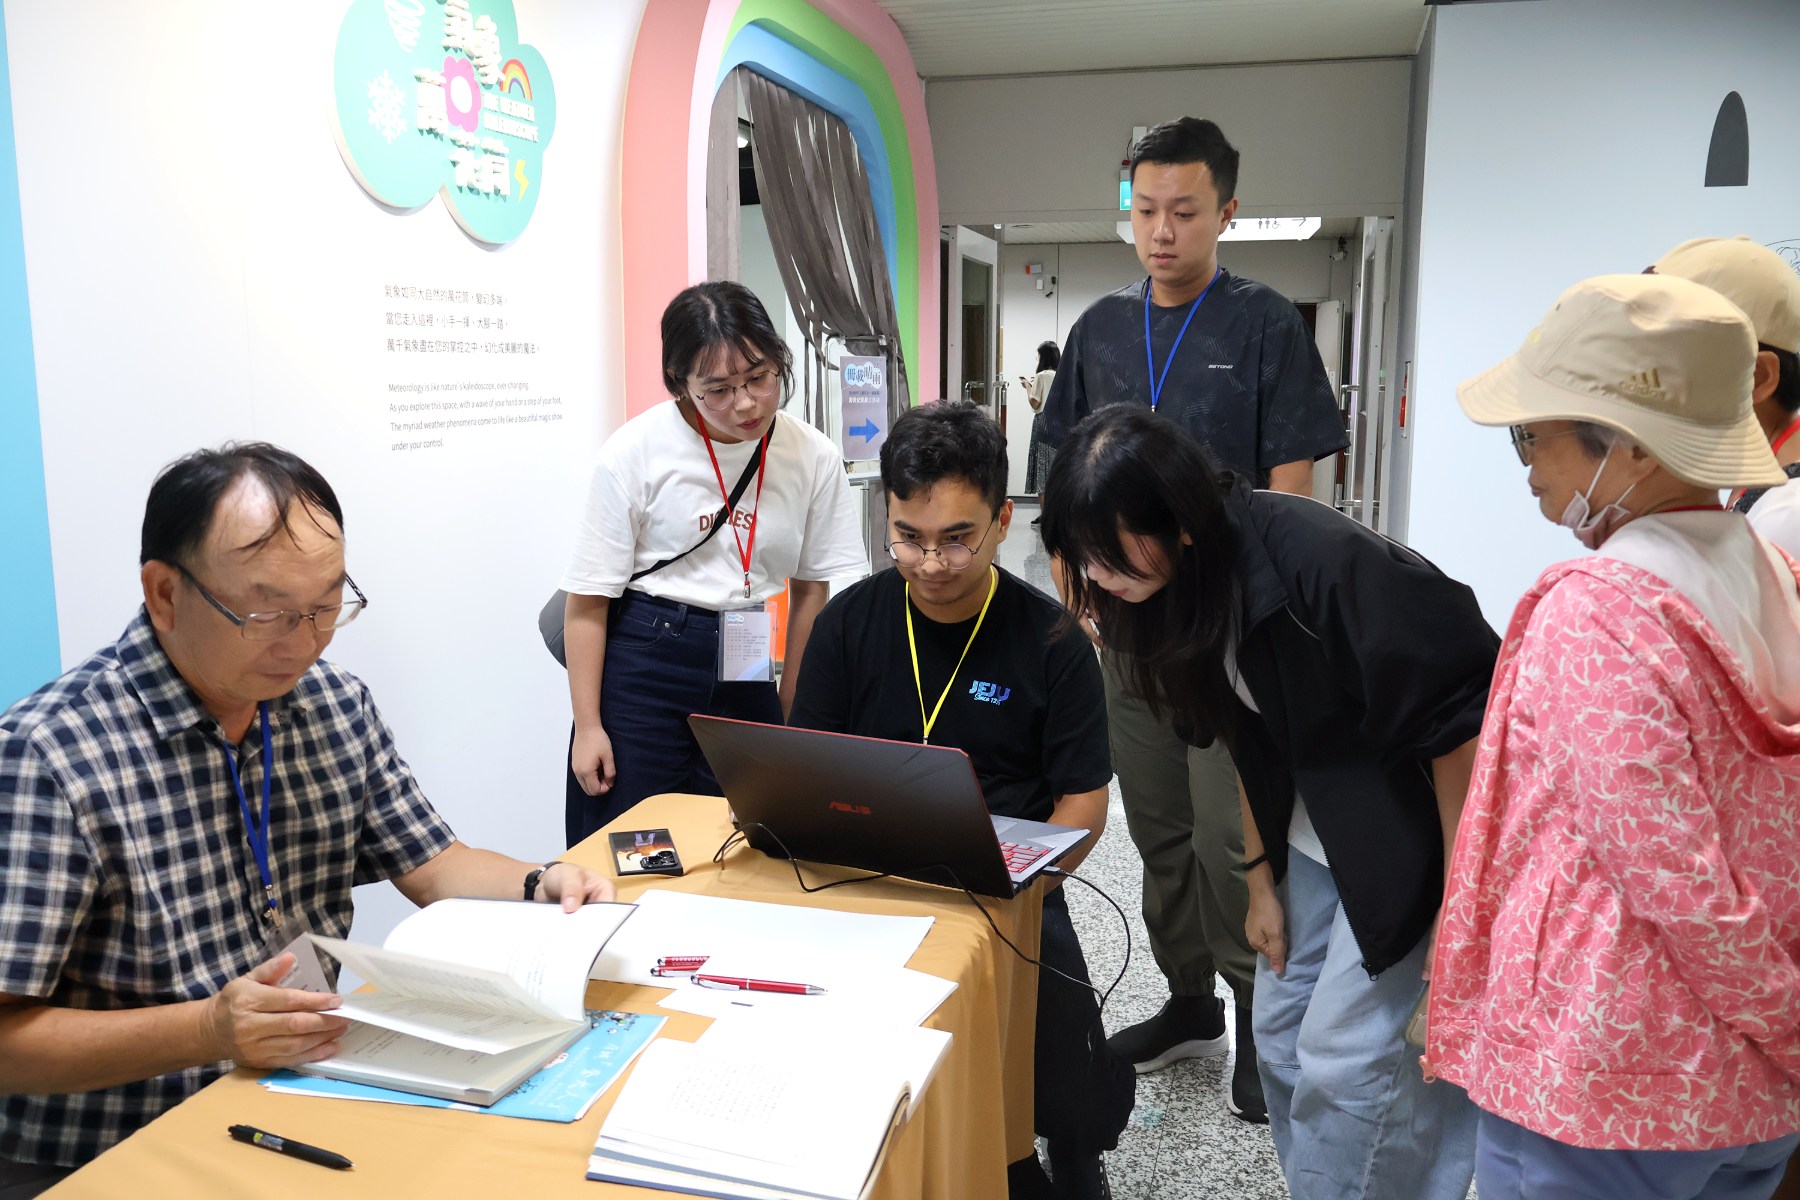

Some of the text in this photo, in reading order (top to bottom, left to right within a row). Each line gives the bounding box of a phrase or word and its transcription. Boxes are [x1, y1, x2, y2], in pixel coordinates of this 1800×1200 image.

[388, 382, 424, 395] Meteorology
[425, 384, 430, 392] is
[430, 383, 440, 392] like
[389, 403, 397, 412] As
[398, 404, 409, 414] you
[410, 402, 431, 413] explore
[431, 401, 441, 410] this
[459, 399, 471, 409] with
[475, 400, 489, 408] wave
[390, 422, 402, 431] The
[402, 420, 423, 433] myriad
[423, 419, 446, 430] weather
[446, 418, 478, 430] phenomena
[477, 417, 492, 426] come
[391, 440, 409, 451] under
[409, 441, 423, 452] your
[968, 680, 1011, 702] JEJU
